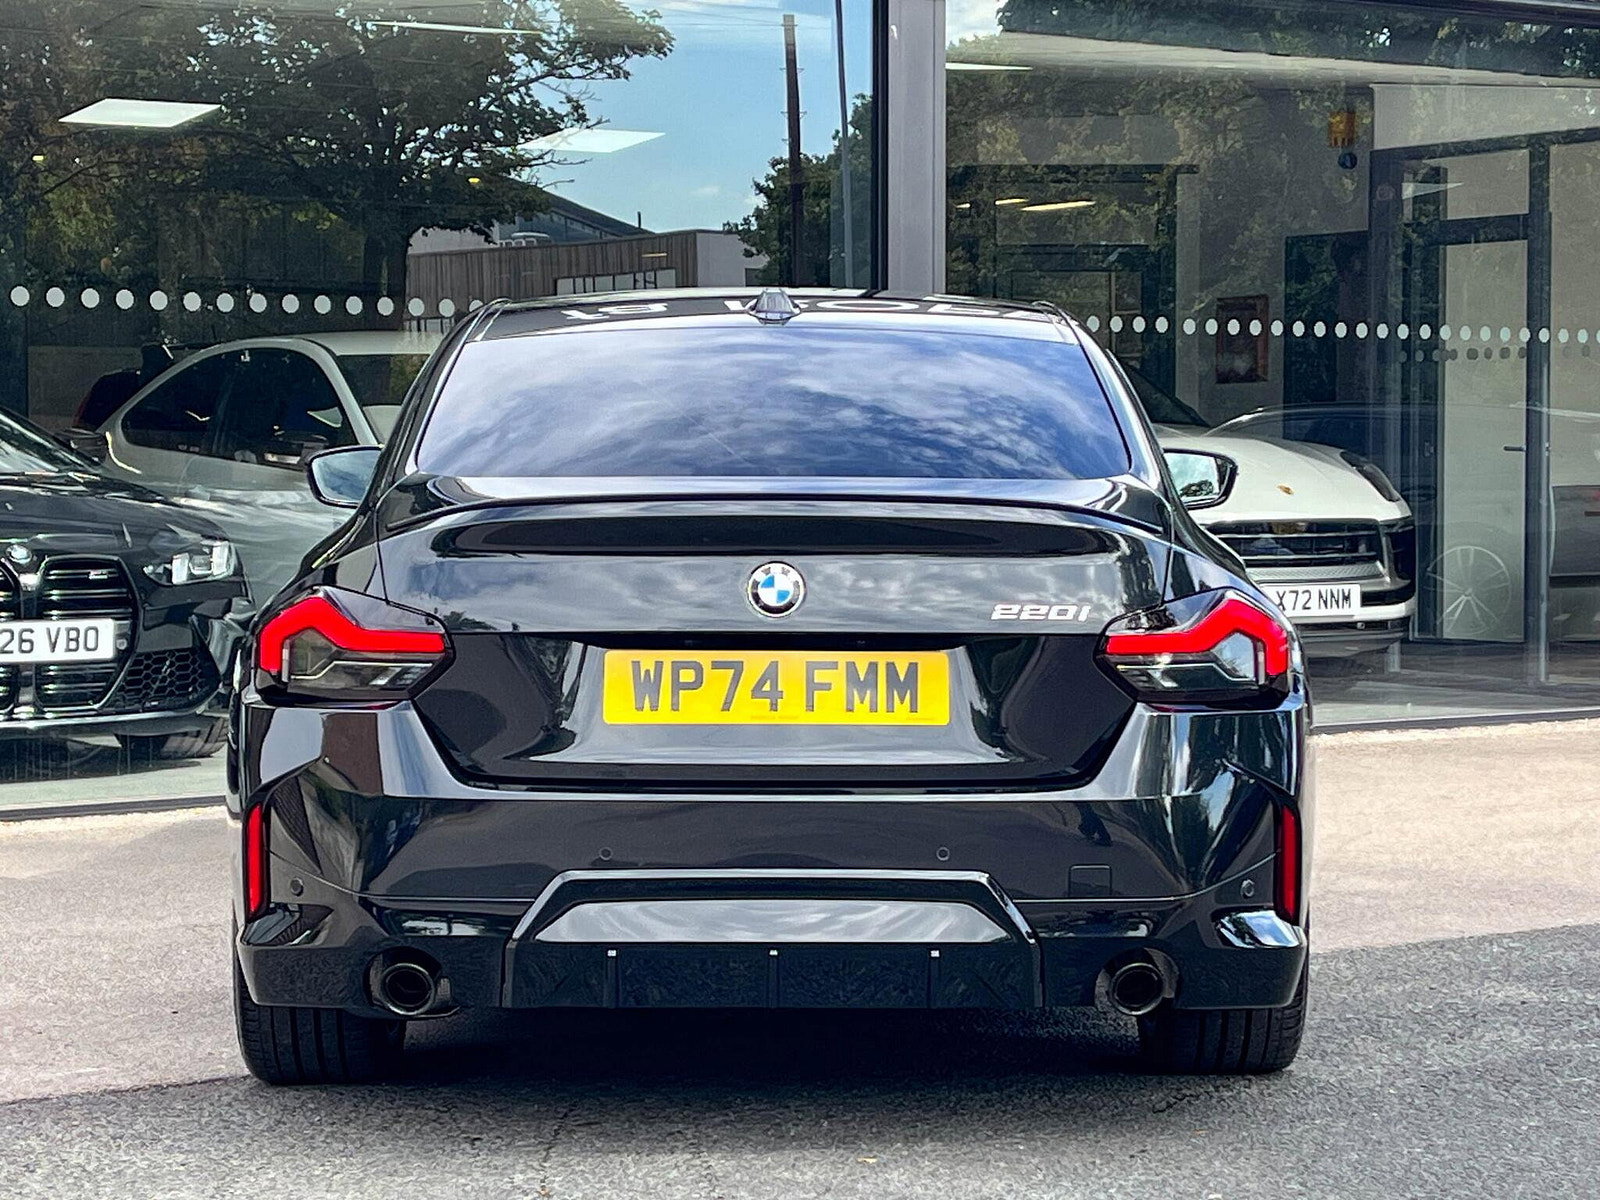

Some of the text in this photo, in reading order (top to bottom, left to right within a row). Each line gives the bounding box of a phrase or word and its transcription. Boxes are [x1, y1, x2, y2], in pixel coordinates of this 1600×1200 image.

[1276, 588, 1351, 611] X72 NNM
[991, 604, 1091, 621] 220i
[0, 628, 35, 654] 26
[631, 660, 919, 713] WP74 FMM
